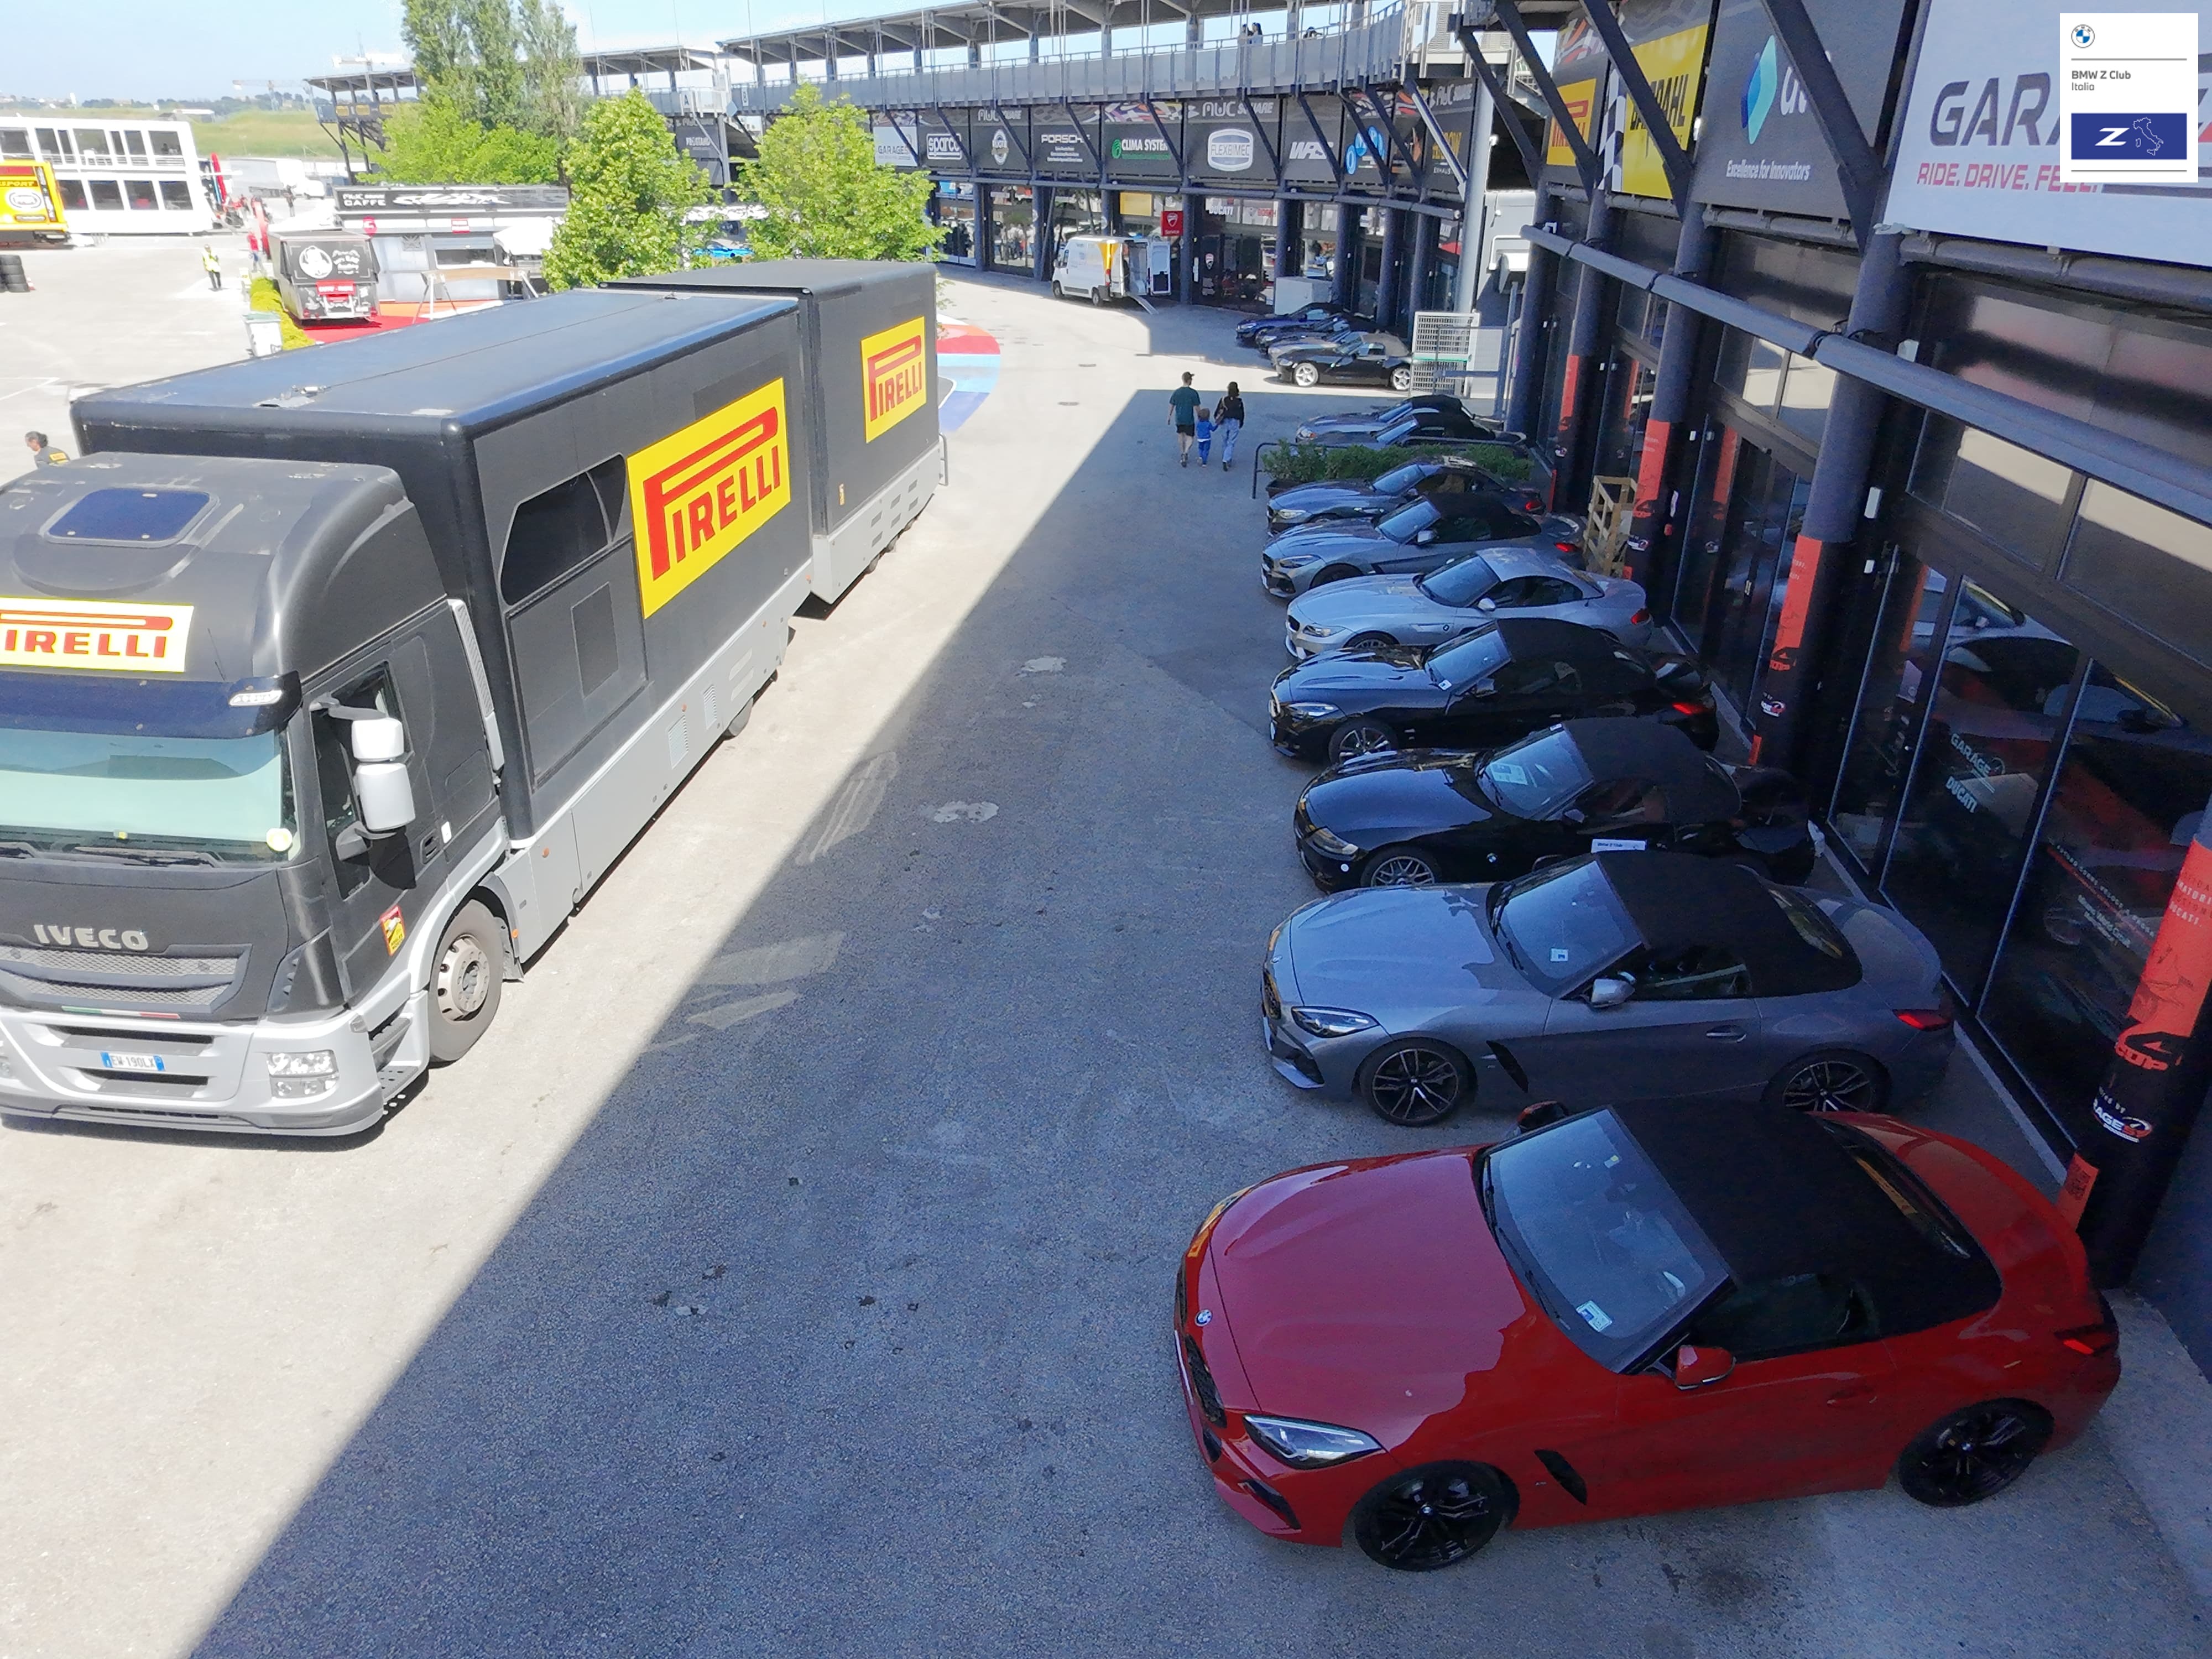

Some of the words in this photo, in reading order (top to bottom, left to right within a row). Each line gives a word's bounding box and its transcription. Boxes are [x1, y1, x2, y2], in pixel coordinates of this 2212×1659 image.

[1237, 102, 1274, 114] SUARE
[1121, 139, 1143, 151] CLIMA
[1917, 163, 1960, 186] RIDE.
[1964, 164, 2029, 190] DRIVE.
[2034, 165, 2098, 192] FE.
[867, 335, 922, 422] PIRELLI
[643, 406, 780, 582] PIRELLI
[33, 924, 149, 951] IVECO
